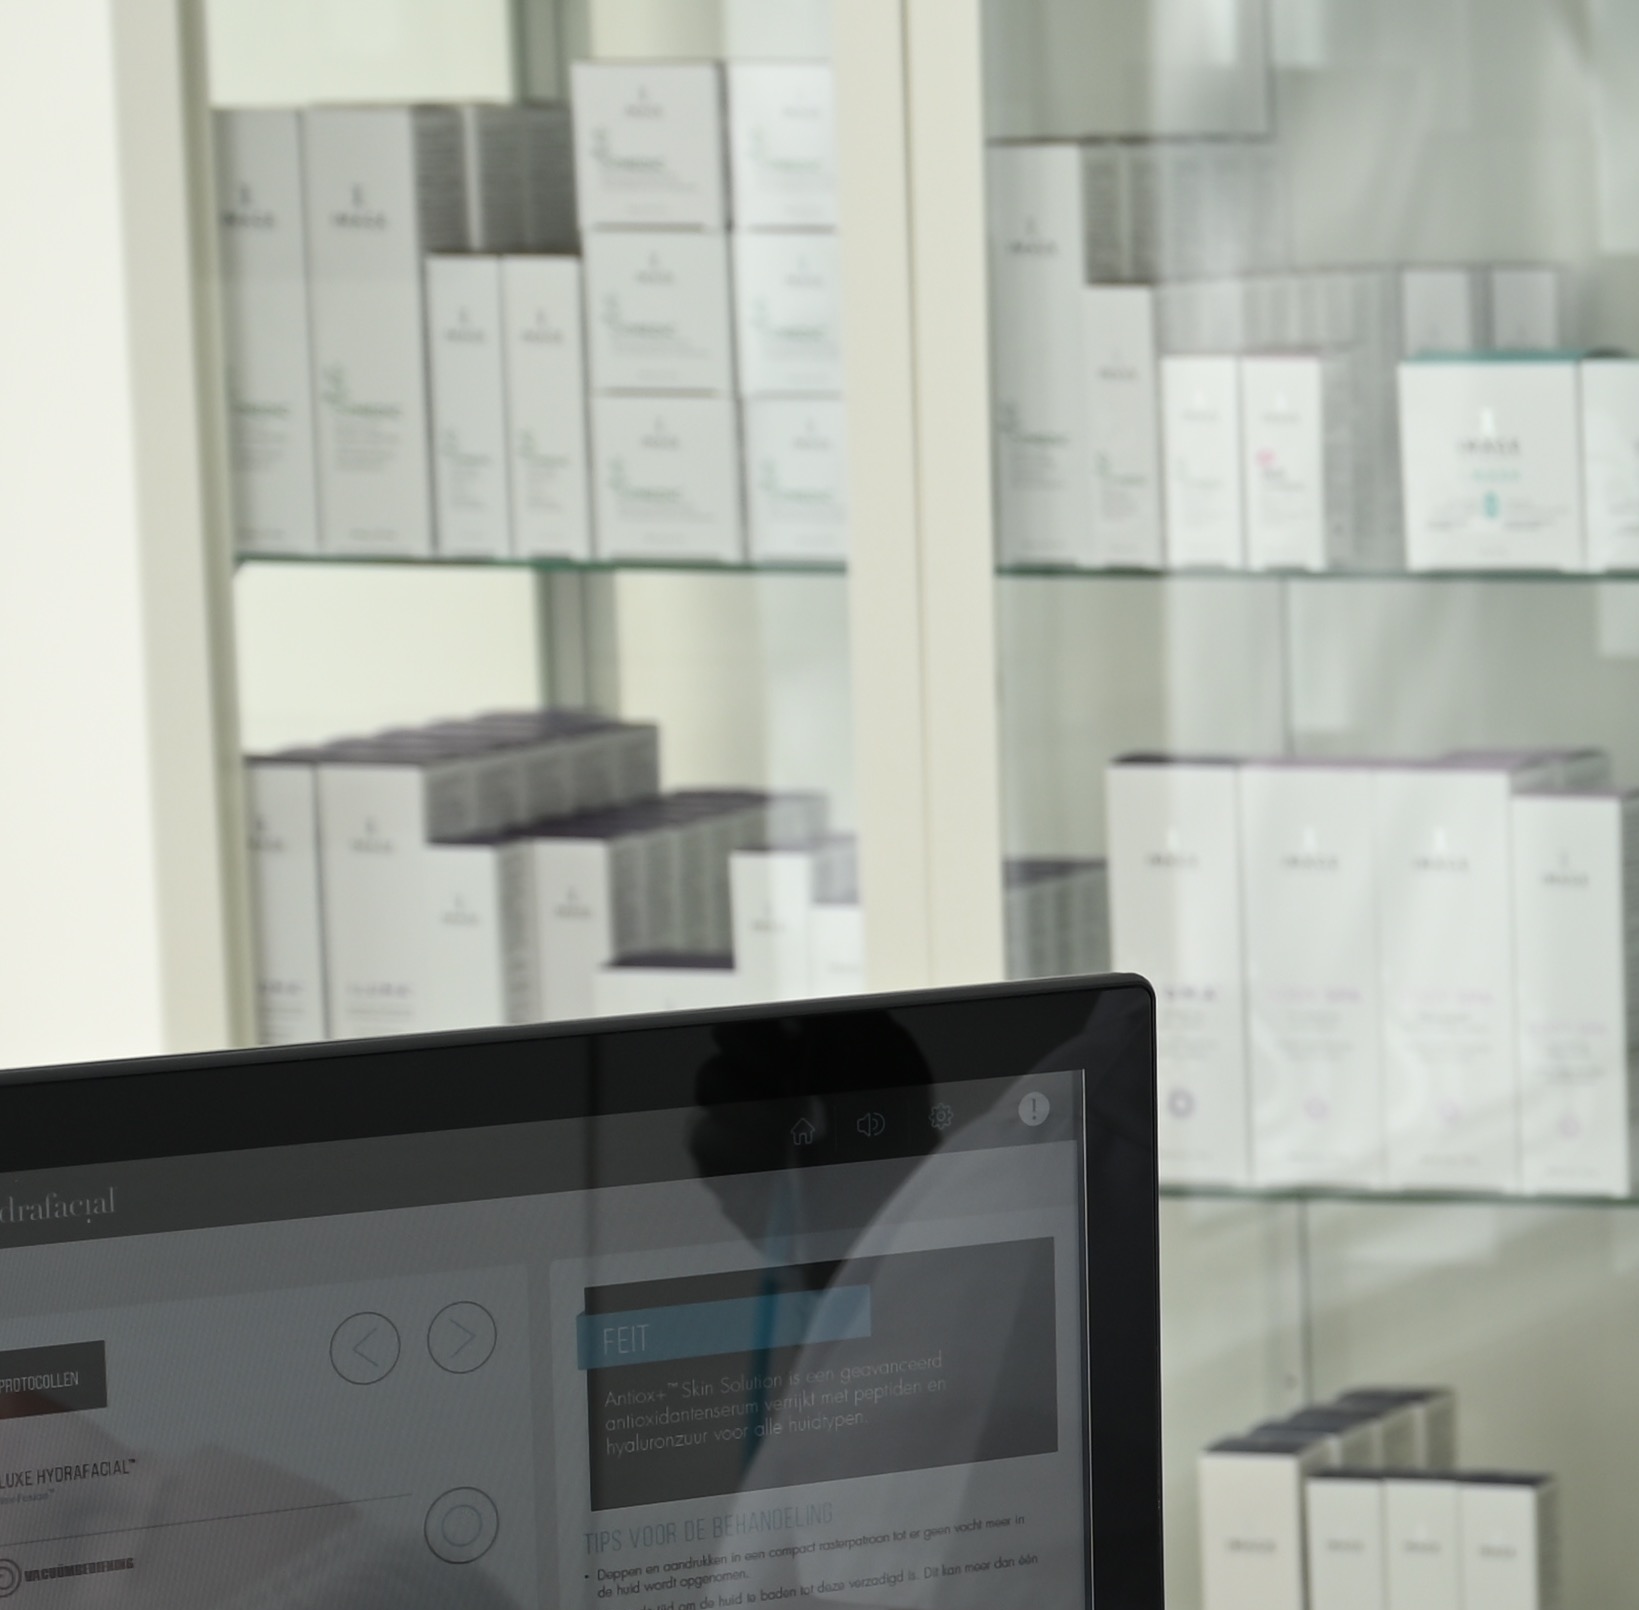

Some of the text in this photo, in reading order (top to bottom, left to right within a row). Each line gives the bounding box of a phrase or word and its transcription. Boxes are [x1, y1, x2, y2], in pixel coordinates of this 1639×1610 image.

[603, 1324, 649, 1356] FEIT
[682, 1379, 714, 1399] Skin
[720, 1373, 782, 1393] Solution
[789, 1373, 801, 1386] is
[806, 1368, 834, 1384] een
[840, 1350, 943, 1385] geavanceerd
[605, 1379, 947, 1431] antioxidantenserum verrijkt met peptiden en
[606, 1411, 868, 1458] hyaluronzuur voor alle huidtypen.
[584, 1503, 833, 1555] TIPS VOOR DE BEHANDELING
[597, 1565, 642, 1583] Deppen
[645, 1562, 660, 1574] en
[663, 1553, 728, 1573] aandrukken
[731, 1551, 741, 1562] in
[768, 1539, 816, 1560] compact
[892, 1530, 907, 1543] tot
[598, 1586, 613, 1599] de
[617, 1582, 640, 1597] huid
[644, 1577, 677, 1593] wordt
[718, 1592, 743, 1608] huid
[942, 1563, 962, 1577] kan
